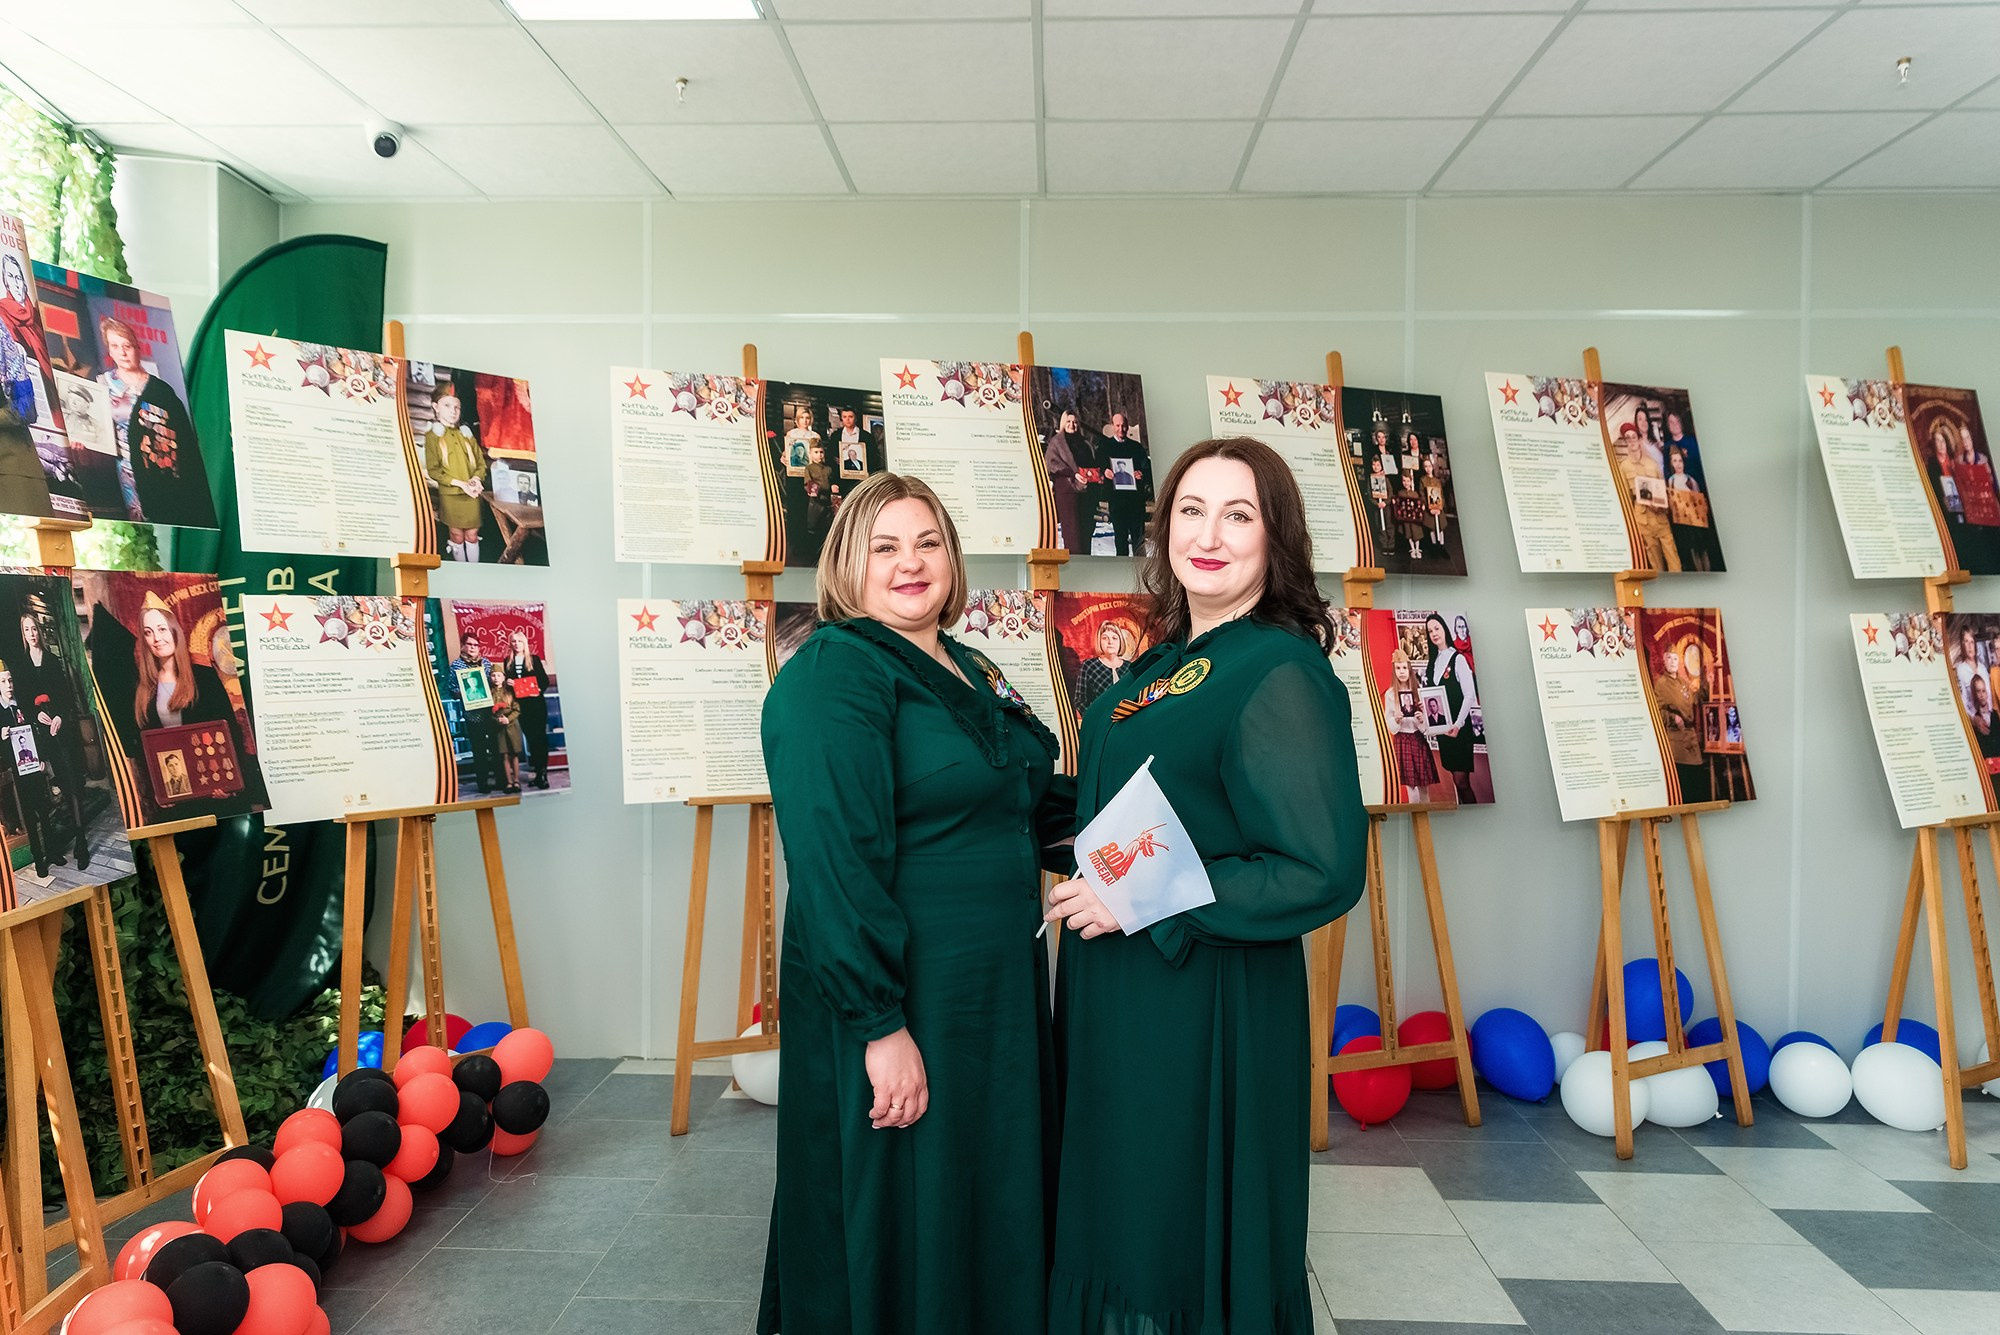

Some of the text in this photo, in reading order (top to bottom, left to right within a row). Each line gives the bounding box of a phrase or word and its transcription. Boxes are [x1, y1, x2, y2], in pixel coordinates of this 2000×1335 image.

[241, 373, 286, 383] КИТЕЛЬ
[242, 380, 292, 391] ПОБЕДЫ
[621, 402, 659, 410] КИТЕЛЬ
[621, 409, 664, 417] ПОБЕДЫ
[1088, 850, 1116, 886] ПОБЕДА!
